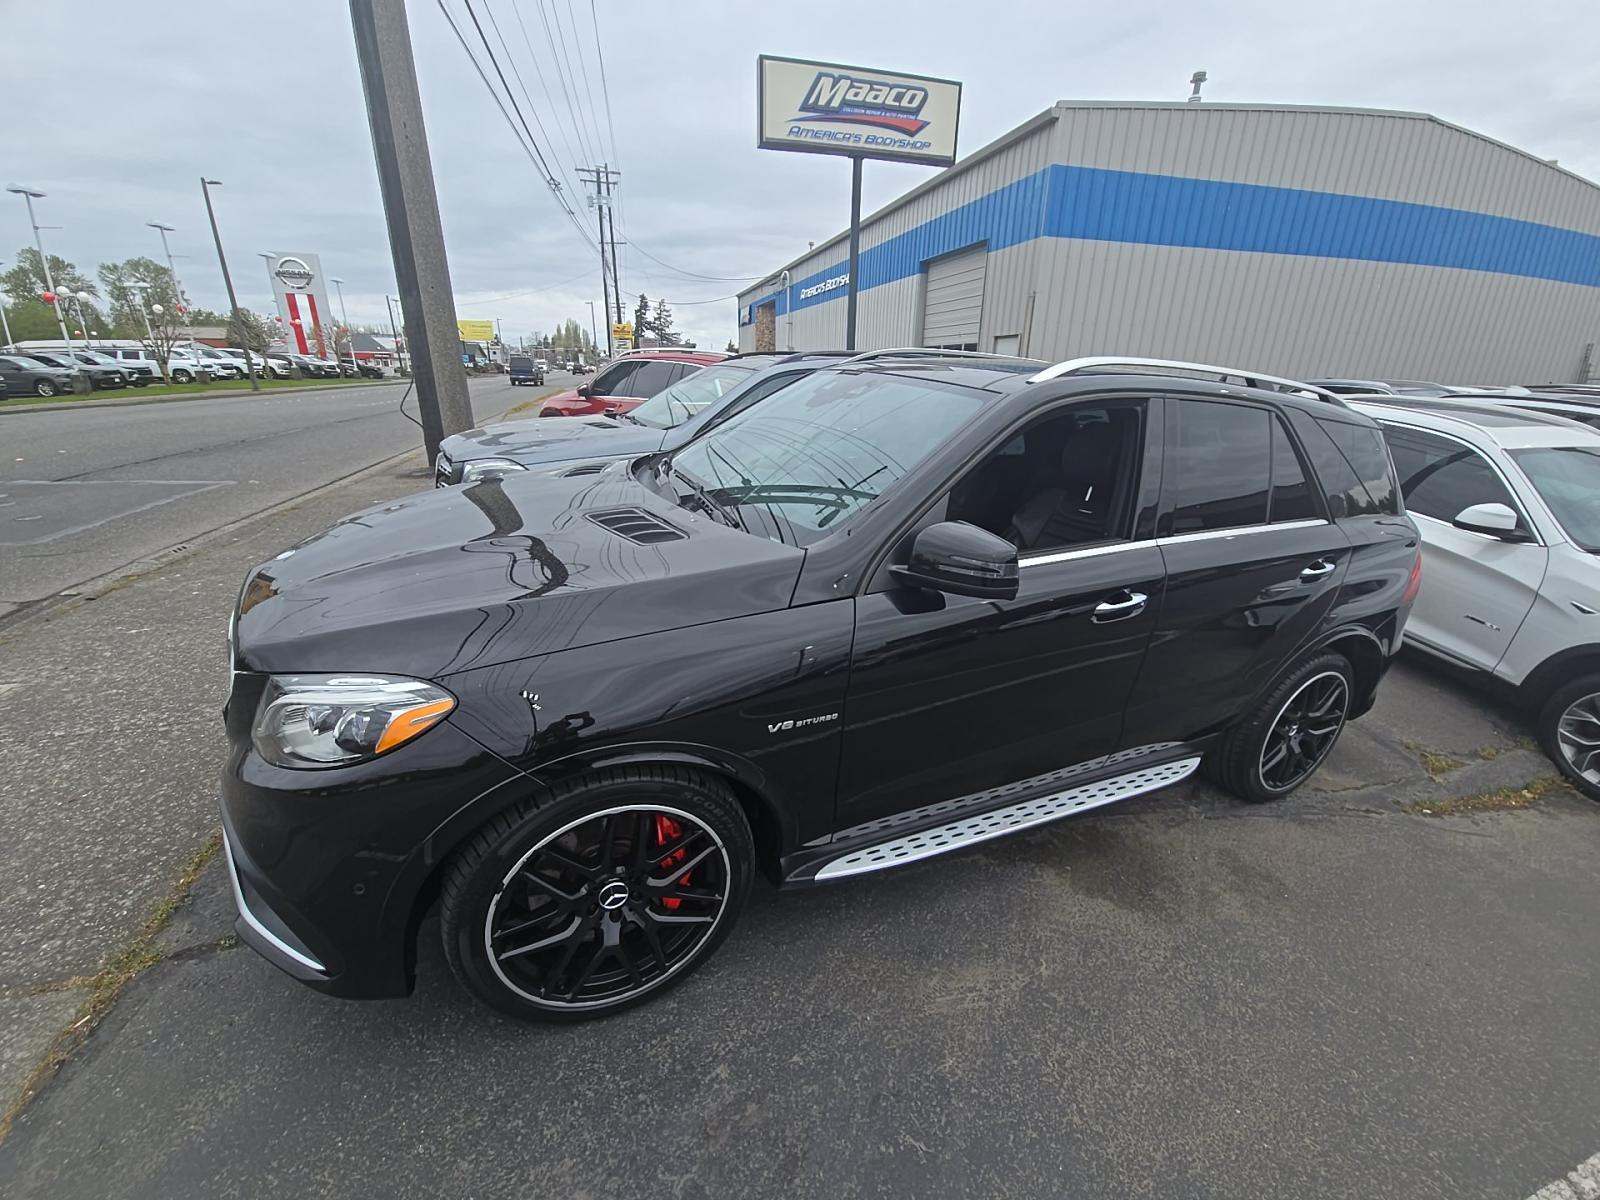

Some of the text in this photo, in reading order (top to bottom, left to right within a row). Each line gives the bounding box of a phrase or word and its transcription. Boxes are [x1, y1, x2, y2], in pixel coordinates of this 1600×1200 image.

[805, 74, 927, 109] Maaco
[788, 125, 932, 151] AMERICA'S BODYSHOP
[768, 713, 839, 733] V8 BITURBO
